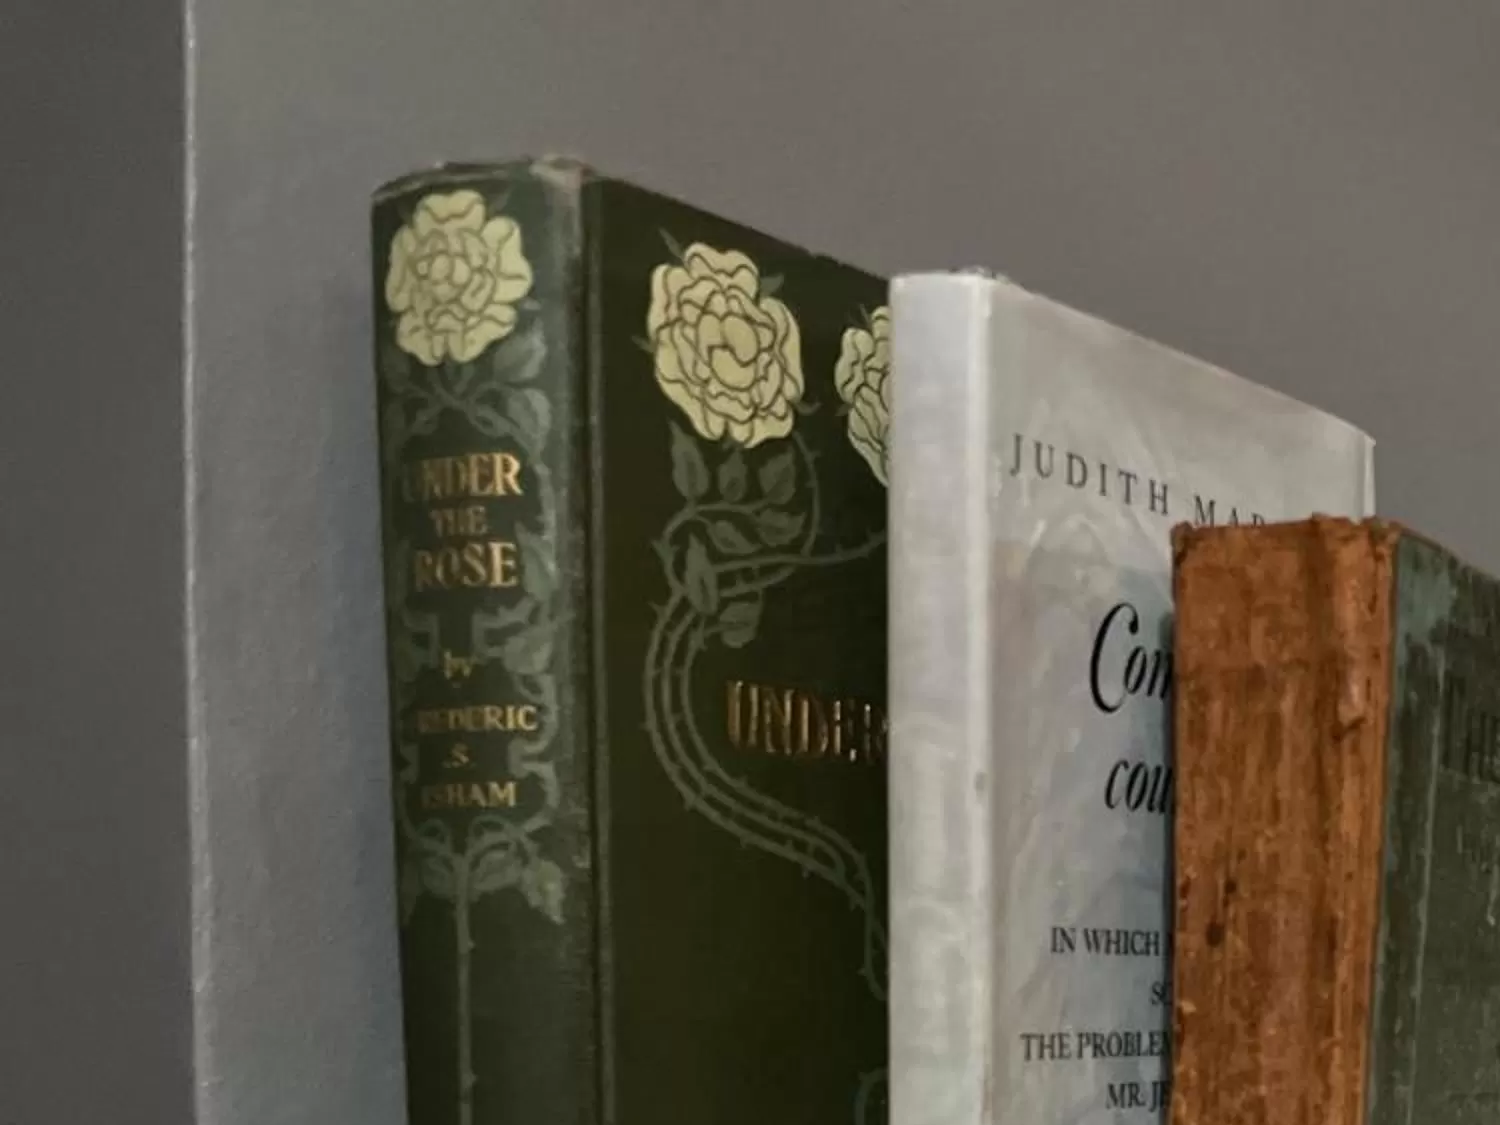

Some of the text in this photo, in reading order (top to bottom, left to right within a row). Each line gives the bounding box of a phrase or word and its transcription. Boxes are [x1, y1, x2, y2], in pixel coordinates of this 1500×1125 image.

[1010, 433, 1170, 516] JUDITH
[414, 541, 518, 591] ROSE
[1051, 927, 1075, 953] IN
[1083, 928, 1160, 956] WHICH
[1020, 1032, 1072, 1061] THE
